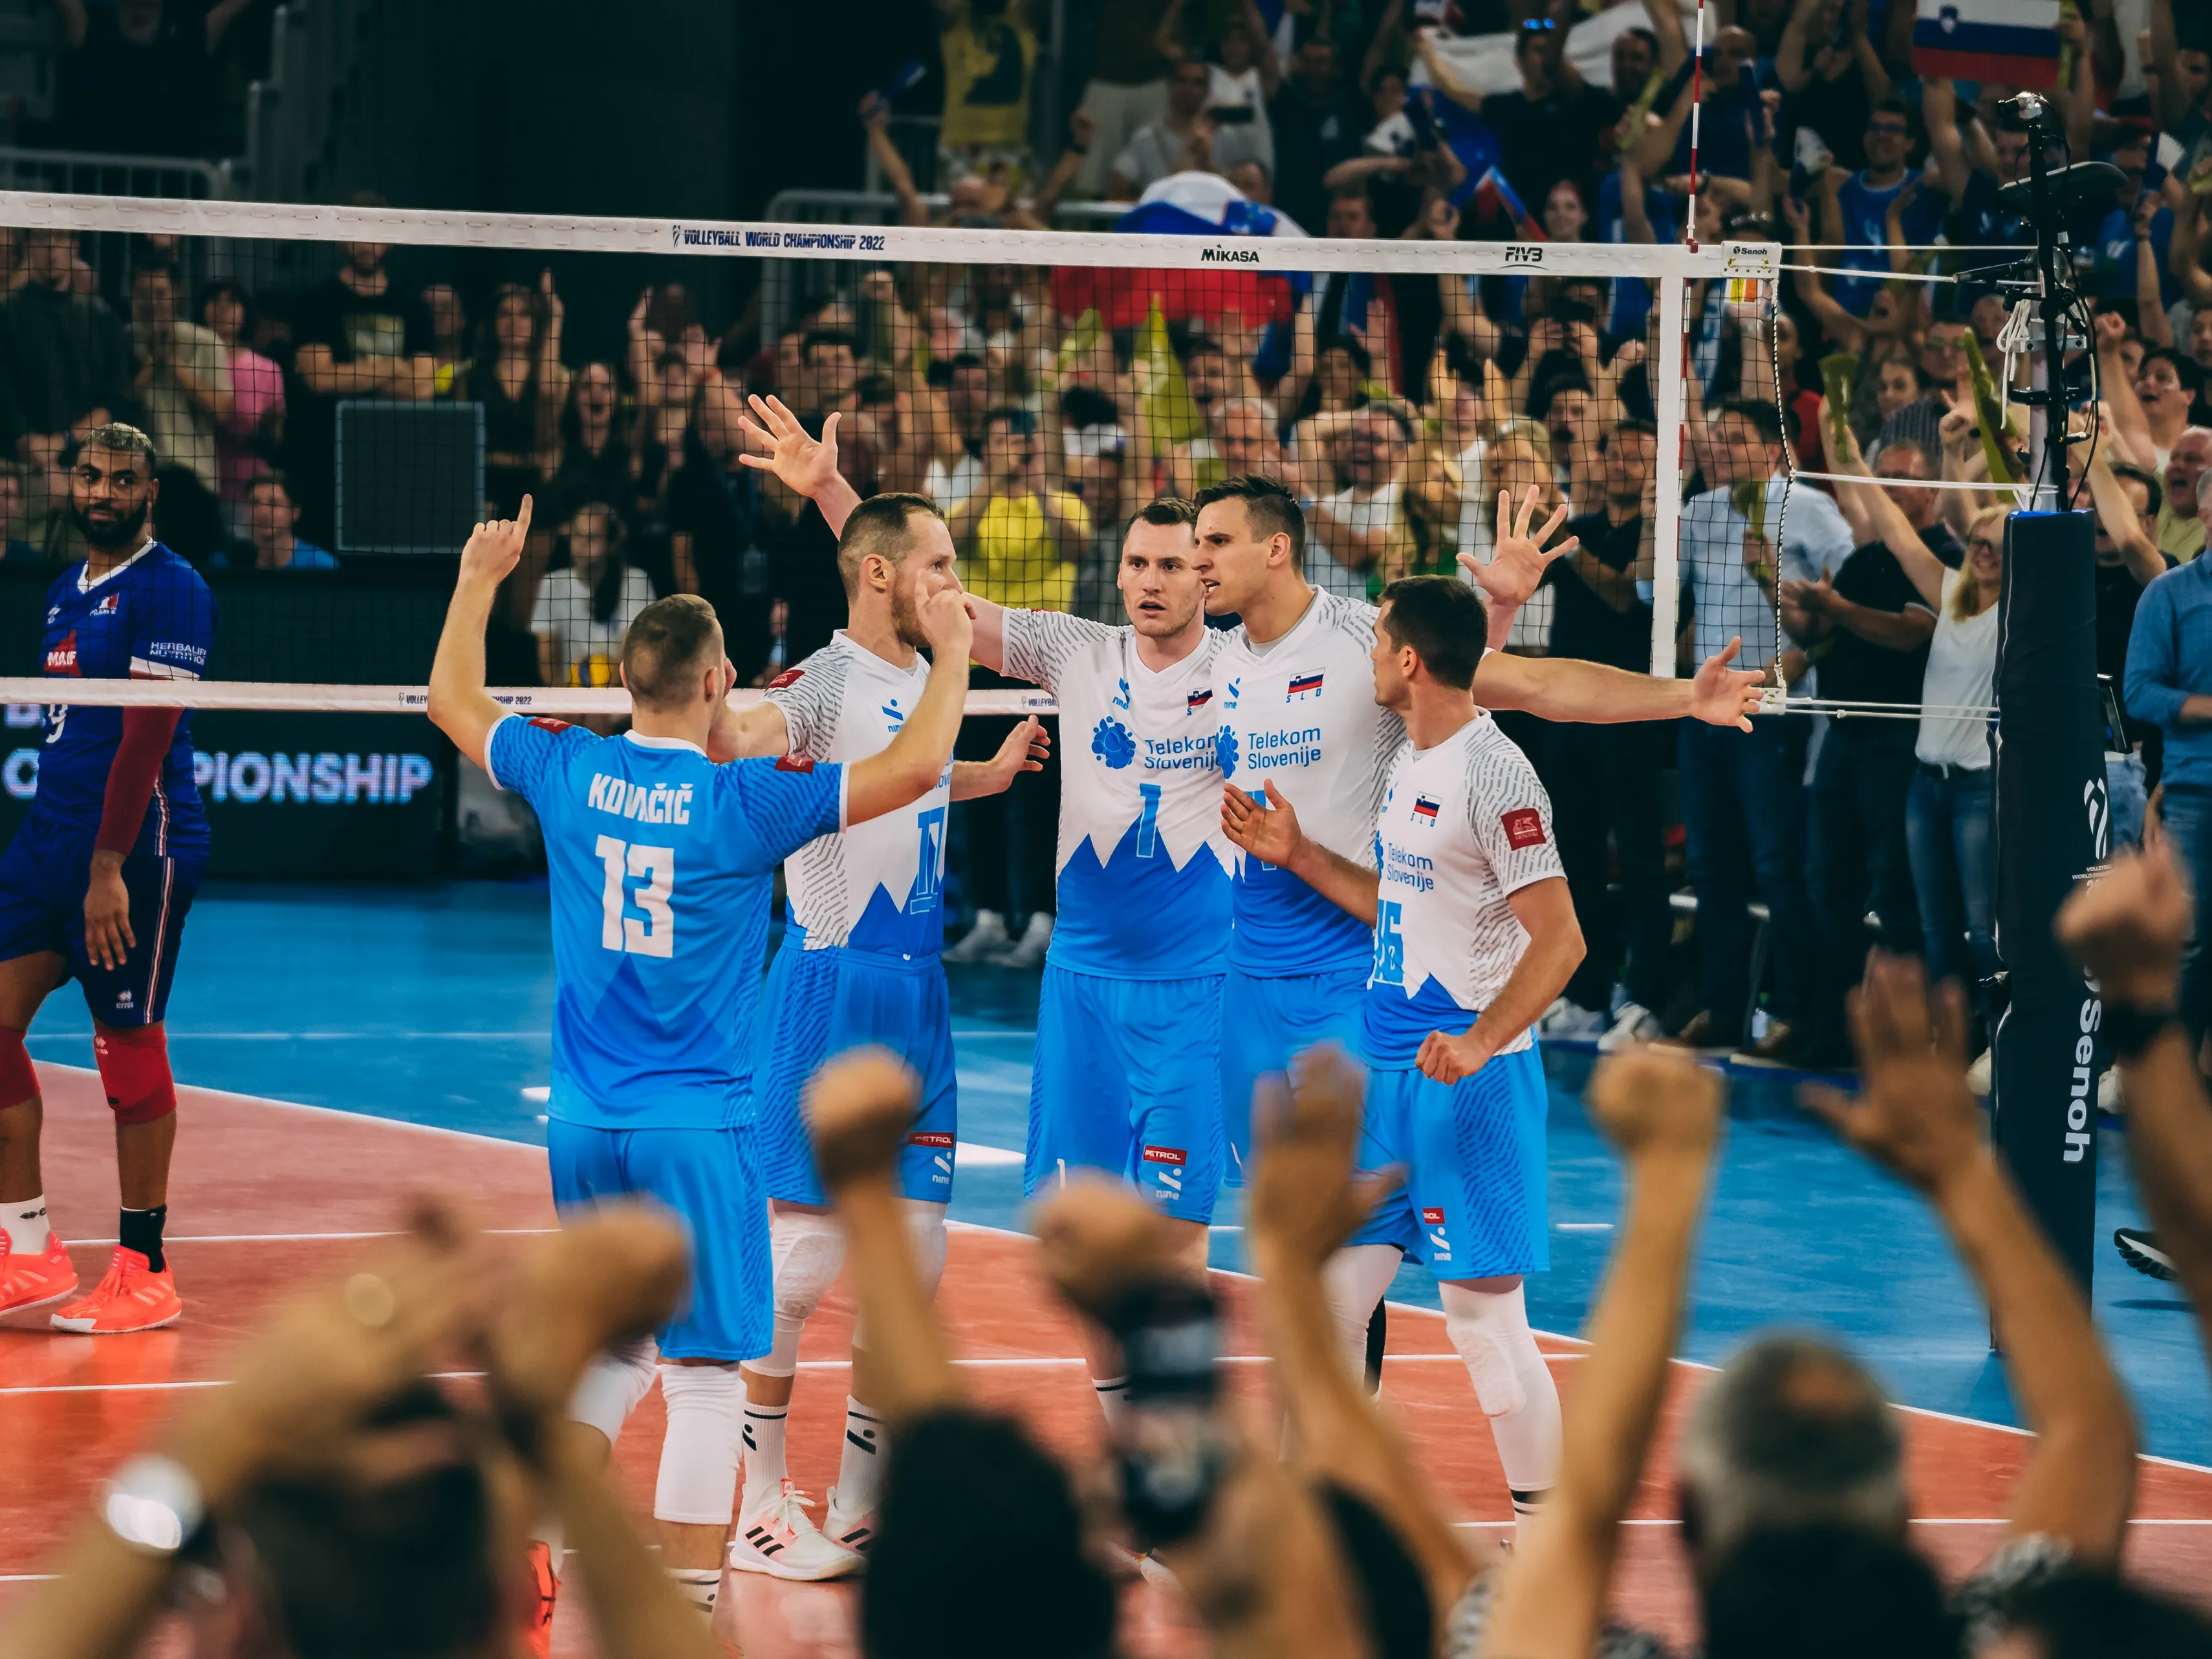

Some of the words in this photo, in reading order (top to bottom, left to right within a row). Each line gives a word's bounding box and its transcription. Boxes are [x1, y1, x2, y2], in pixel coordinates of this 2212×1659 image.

[684, 229, 741, 246] VOLLEYBALL
[745, 232, 782, 248] WORLD
[783, 233, 856, 250] CHAMPIONSHIP
[859, 235, 885, 251] 2022
[1200, 244, 1260, 263] MIKASA
[1504, 246, 1543, 262] FIVB
[47, 651, 77, 667] MAIF
[406, 694, 428, 704] VOLLEY
[515, 696, 532, 705] 2022
[1248, 727, 1321, 750] Telekom
[1248, 746, 1321, 770] Slovenije
[587, 772, 693, 825] KOVAČIČ
[1388, 843, 1433, 871] Telekom
[1387, 864, 1434, 893] Slovenije
[595, 834, 675, 958] 13
[2063, 999, 2101, 1162] Senoh
[1145, 1149, 1181, 1160] PETROL
